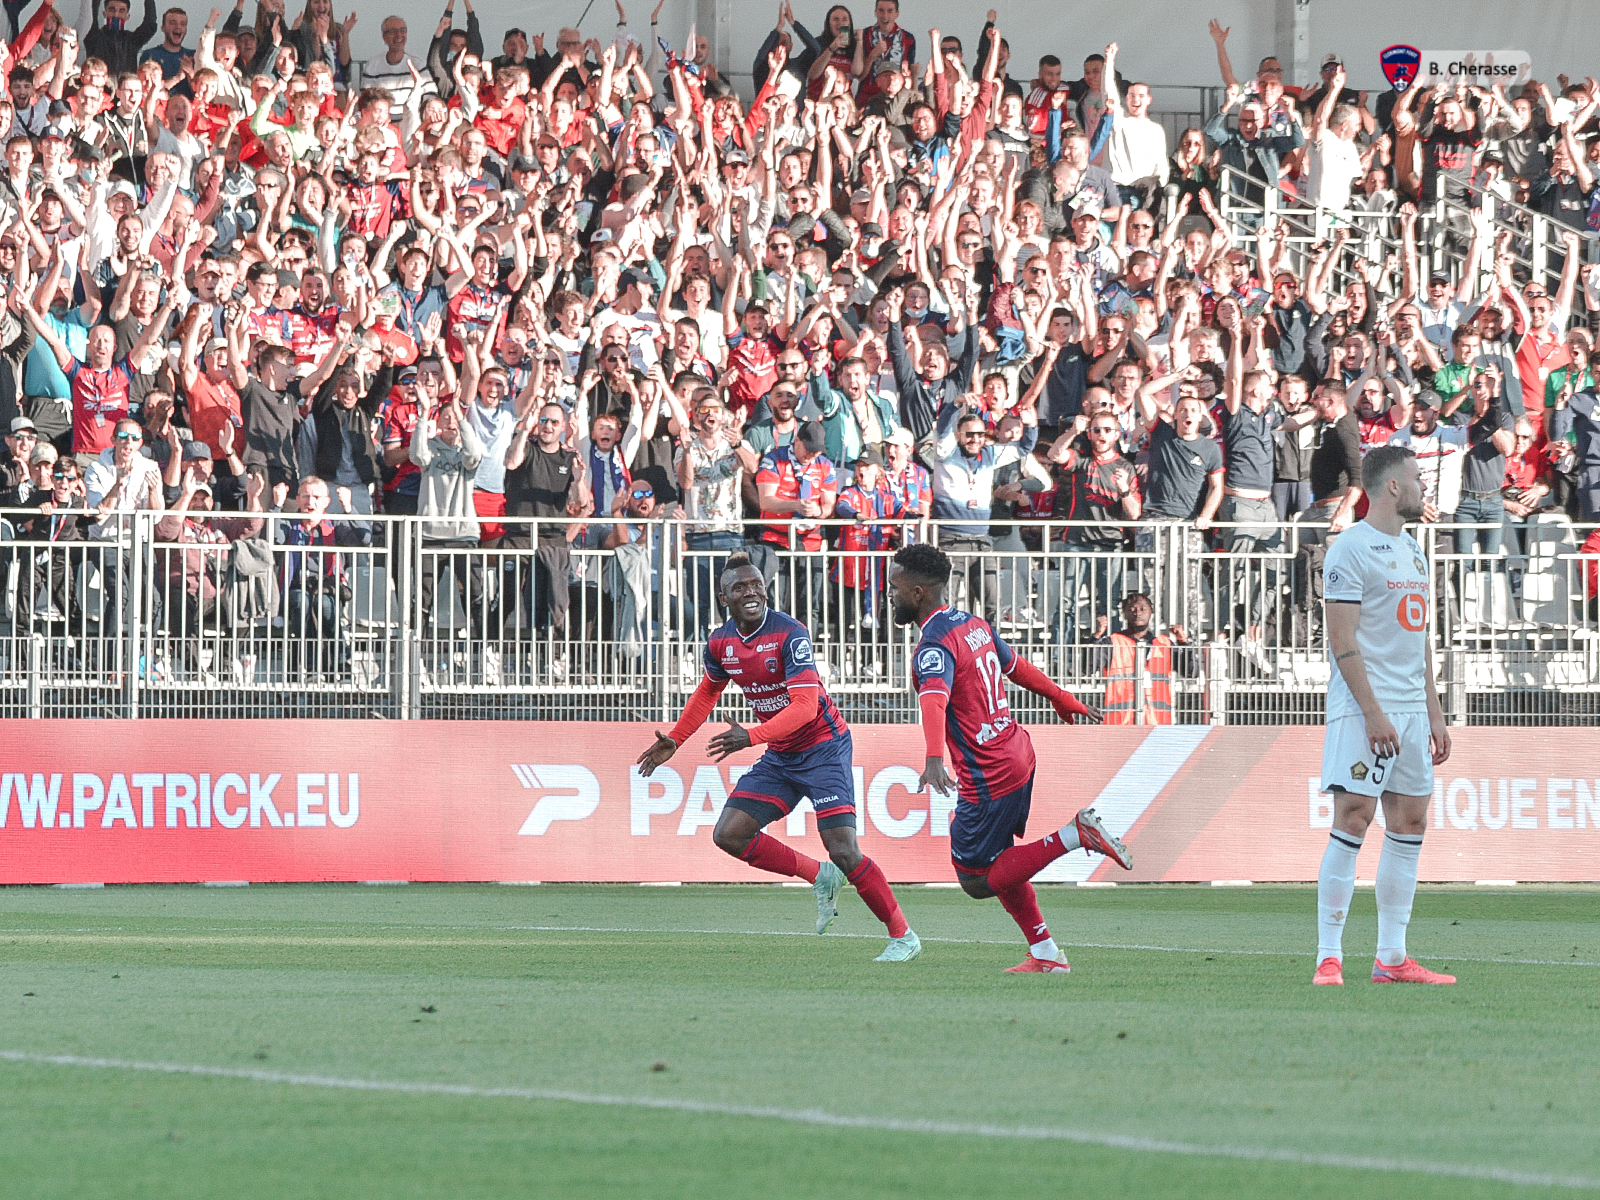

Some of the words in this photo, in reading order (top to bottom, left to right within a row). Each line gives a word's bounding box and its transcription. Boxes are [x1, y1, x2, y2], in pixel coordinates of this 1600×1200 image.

[1387, 579, 1429, 592] boulange
[975, 650, 1009, 715] 12
[1371, 754, 1389, 785] 5
[1308, 777, 1538, 831] BIQUE
